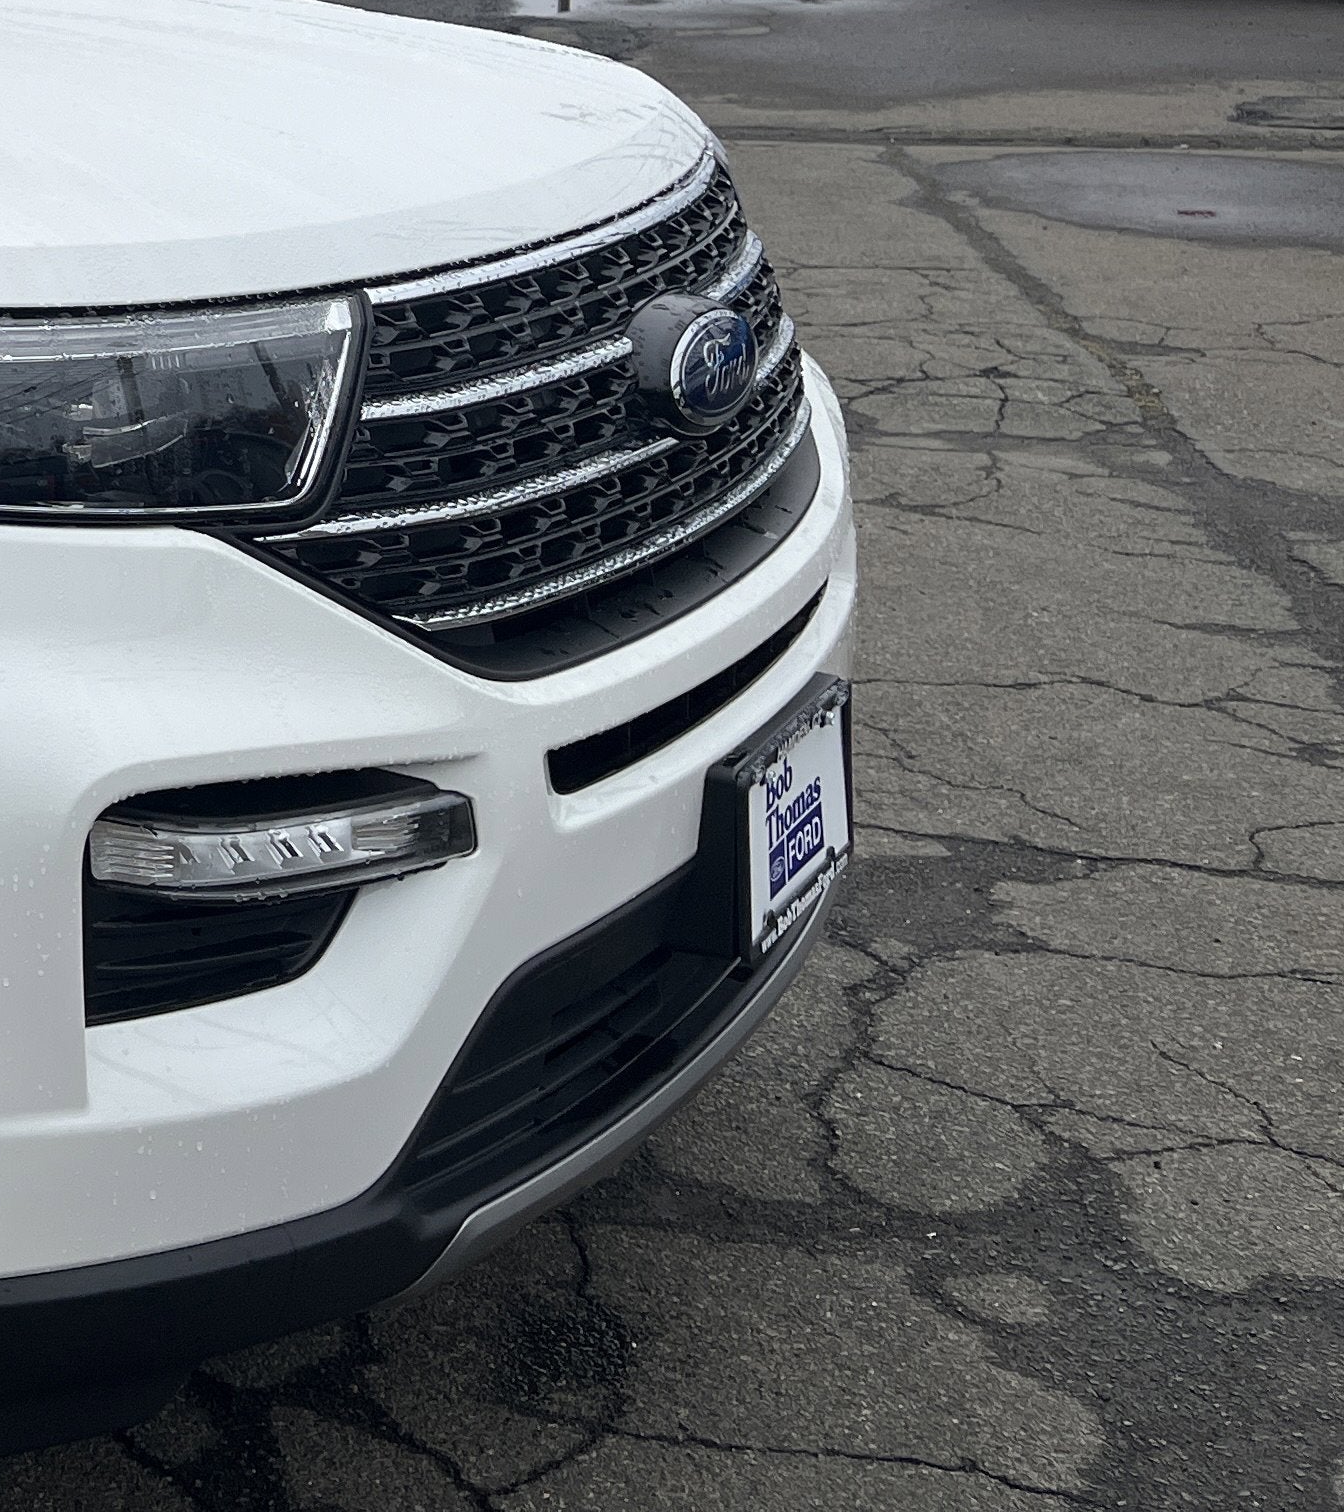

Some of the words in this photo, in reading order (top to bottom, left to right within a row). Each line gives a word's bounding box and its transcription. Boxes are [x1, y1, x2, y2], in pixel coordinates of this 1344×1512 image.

[703, 332, 750, 399] Ford
[765, 758, 793, 814] Bob
[765, 776, 822, 851] Thomas
[788, 815, 823, 871] FORD
